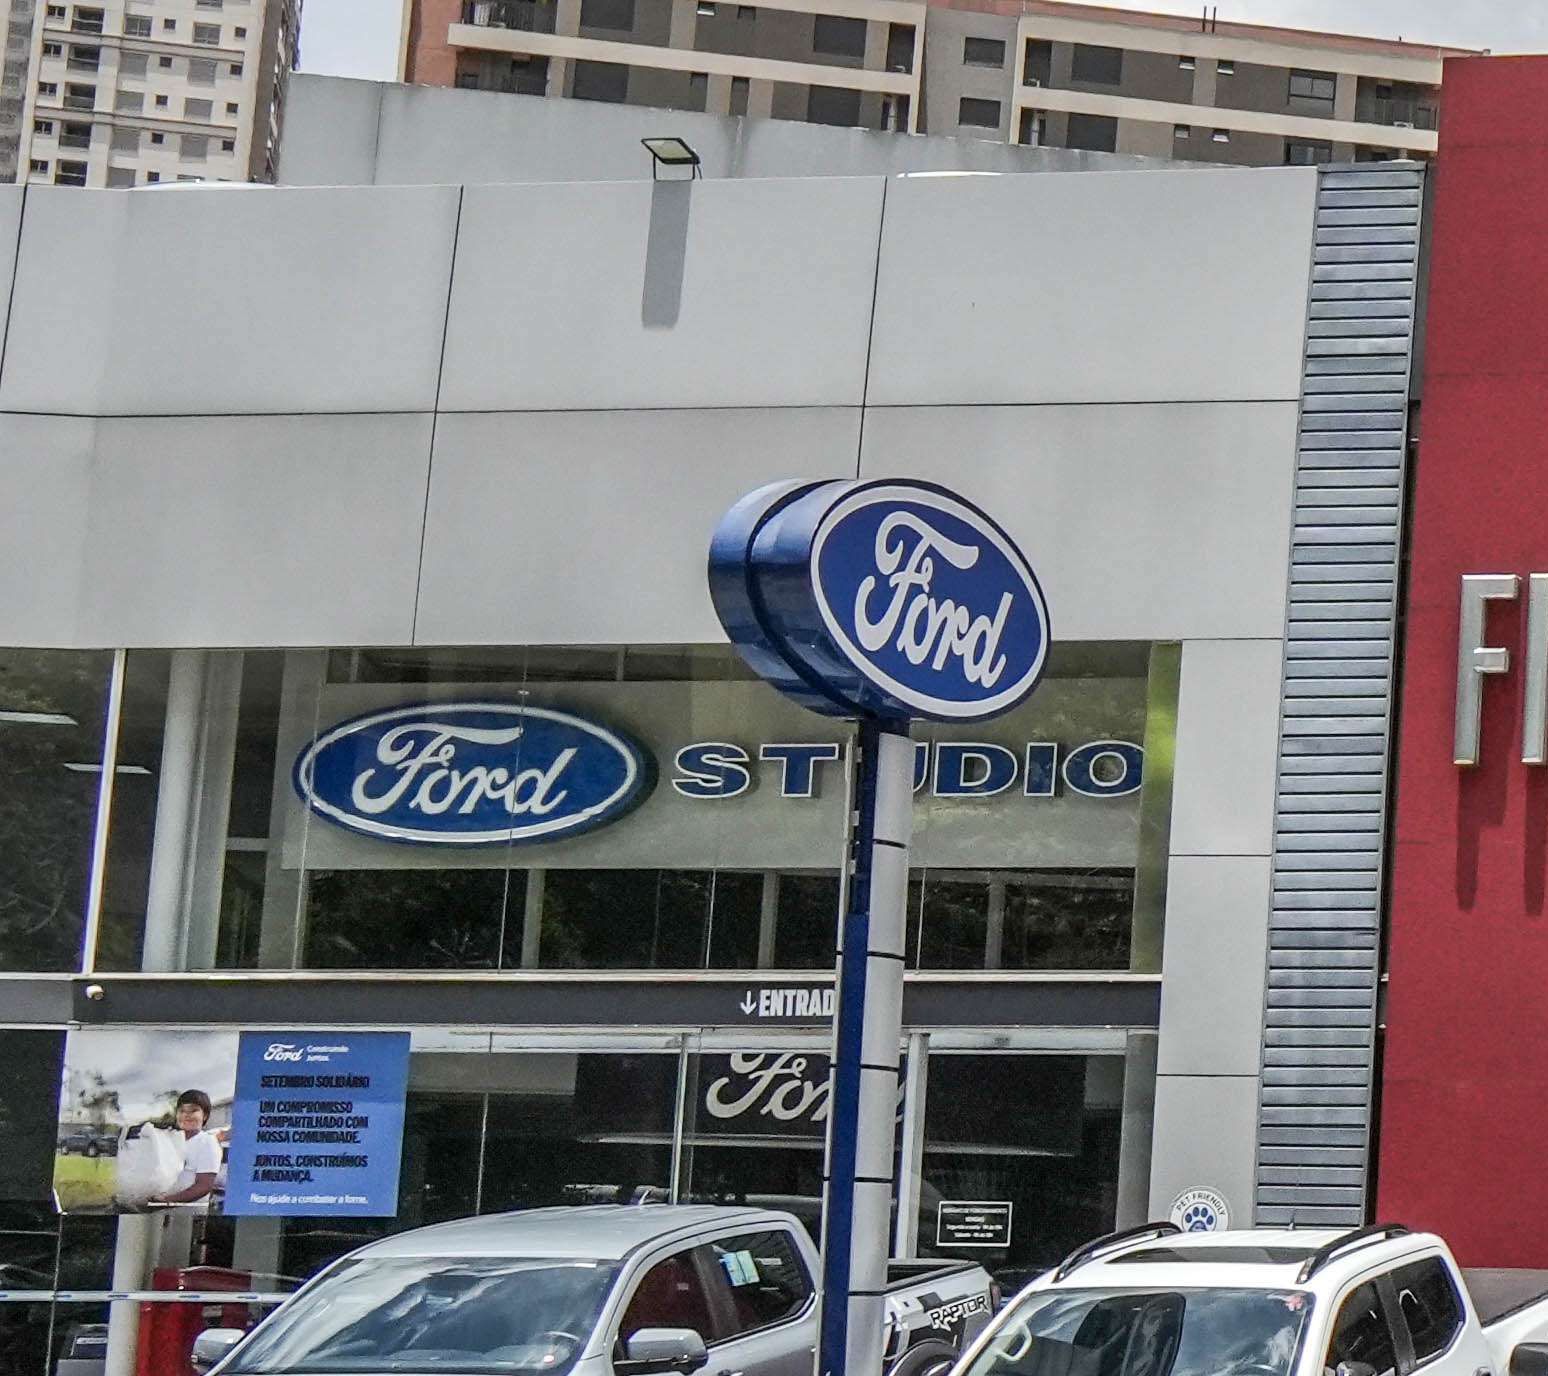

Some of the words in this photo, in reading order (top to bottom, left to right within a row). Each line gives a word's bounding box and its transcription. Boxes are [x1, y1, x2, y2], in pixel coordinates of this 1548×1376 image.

[855, 511, 1014, 688] Ford
[352, 723, 578, 815] Ford
[671, 740, 1144, 799] STDIO
[759, 989, 835, 1017] ENTRAD
[264, 1043, 304, 1061] Ford
[261, 1075, 314, 1088] SETEMBRO
[315, 1072, 369, 1088] SOLIDÁRIO
[259, 1101, 275, 1113] UM
[277, 1101, 353, 1113] COMPROMISSO
[258, 1116, 344, 1128] COMPARTILHADO
[345, 1116, 369, 1128] COM
[256, 1130, 290, 1143] NOSSA
[292, 1130, 361, 1143] COMUNIDADE.
[254, 1155, 294, 1169] JUNTOS,
[295, 1152, 368, 1167] CONSTRUÍMOS
[252, 1170, 260, 1182] A
[261, 1170, 315, 1184] MUDANÇA.
[250, 1194, 266, 1203] Nos
[298, 1194, 337, 1203] combater
[1176, 1195, 1191, 1211] PET
[1192, 1192, 1226, 1216] FRIENDLY
[929, 1293, 990, 1331] RAPTOR
